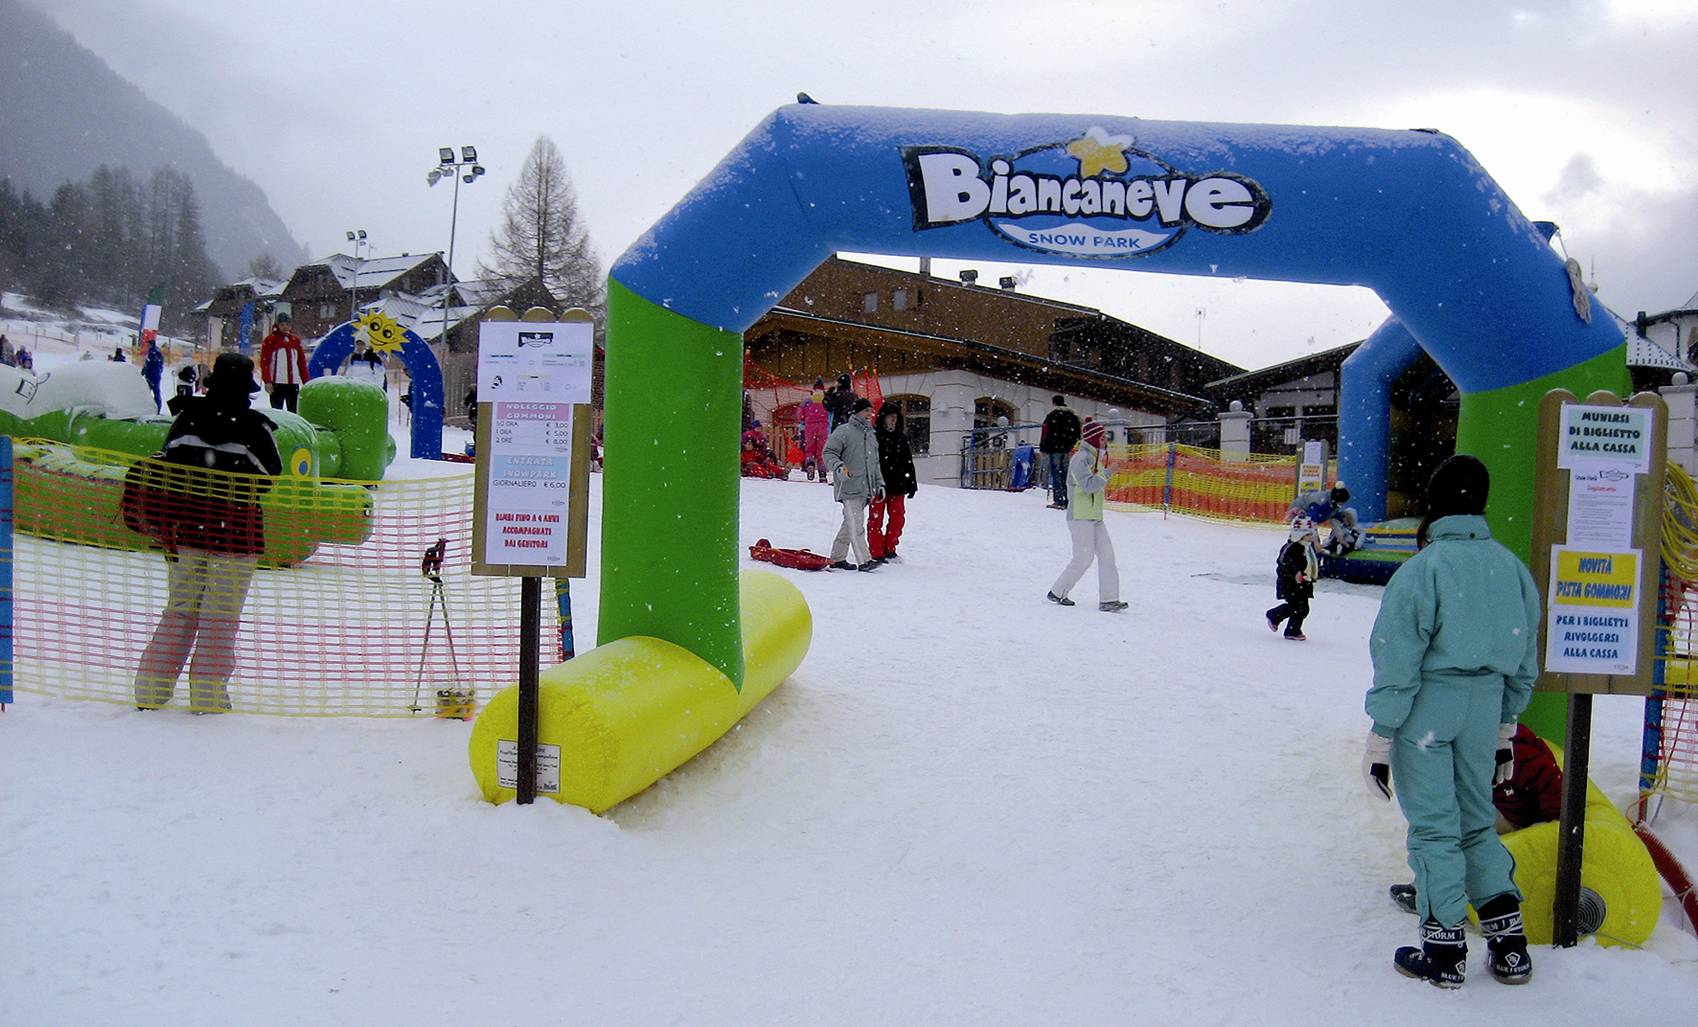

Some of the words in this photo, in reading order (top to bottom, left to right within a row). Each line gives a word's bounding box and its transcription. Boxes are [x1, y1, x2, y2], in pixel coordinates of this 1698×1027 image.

[917, 152, 1254, 228] Biancaneve
[1029, 232, 1087, 247] SNOW
[1092, 236, 1141, 249] PARK
[1581, 412, 1630, 423] MUNIRSI
[1568, 426, 1581, 436] DI
[1583, 427, 1640, 439] BIGLIETTO
[1570, 441, 1599, 452] ALLA
[1602, 443, 1636, 454] CASSA
[507, 457, 553, 465] ENTRATA
[515, 514, 531, 522] FINO
[532, 514, 537, 522] A
[543, 515, 560, 523] ANNI
[502, 526, 552, 535] ACCOMPAGNATI
[504, 539, 516, 547] DAI
[517, 540, 548, 549] GENITORI
[1578, 555, 1613, 574] NOVITÀ
[1556, 582, 1582, 598] PISTA
[1584, 582, 1632, 600] GOMMONI
[1556, 616, 1575, 625] PER
[1577, 616, 1581, 625] I
[1583, 616, 1629, 627] BIGLIETTI
[1564, 632, 1619, 643] RIVOLGERSI
[1563, 647, 1587, 658] ALLA
[1590, 648, 1618, 659] CASSA
